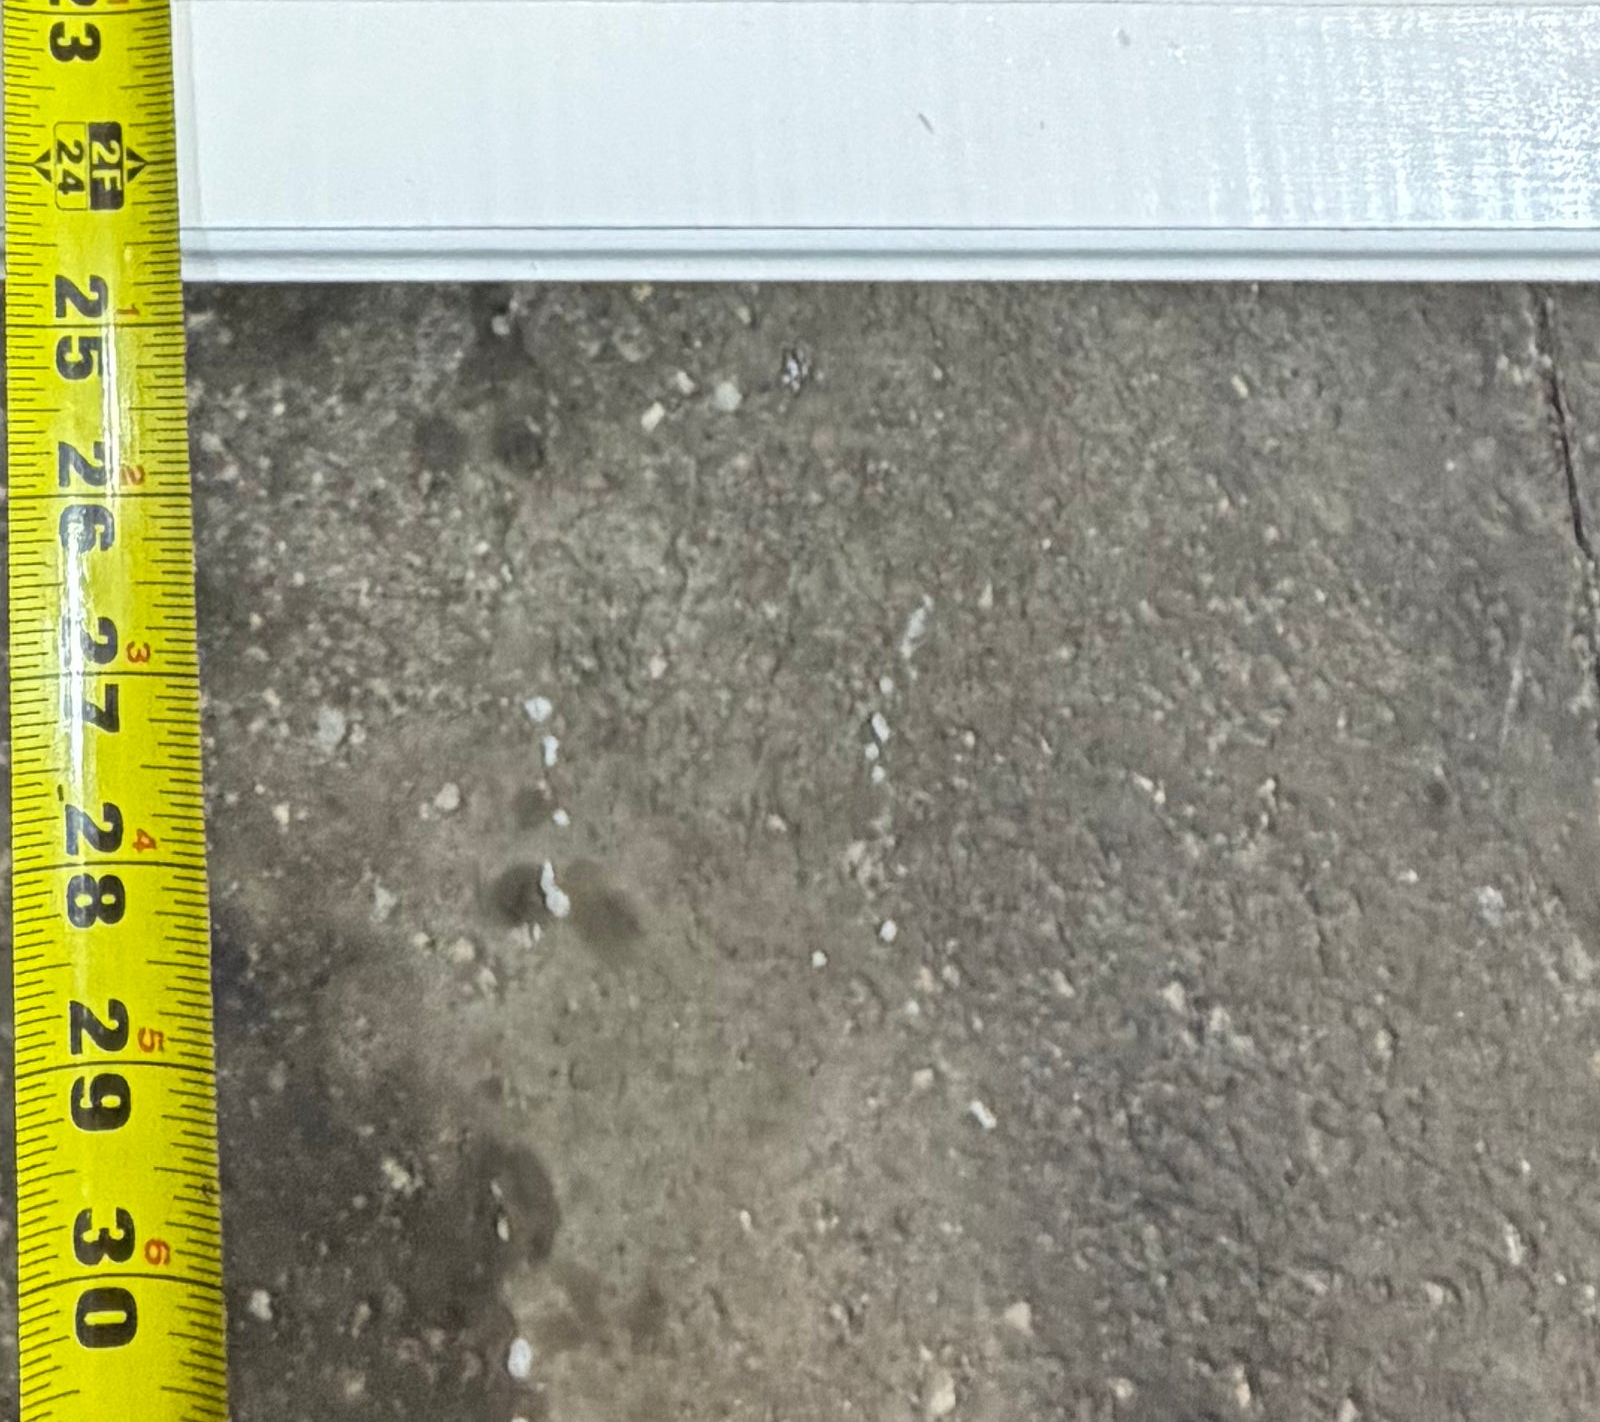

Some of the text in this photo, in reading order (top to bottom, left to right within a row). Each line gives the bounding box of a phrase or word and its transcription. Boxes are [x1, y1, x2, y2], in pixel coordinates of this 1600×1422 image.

[56, 138, 86, 196] 24
[91, 139, 124, 192] 2F
[55, 274, 108, 381] 25
[116, 303, 140, 316] 1
[58, 441, 115, 553] 26
[120, 464, 146, 486] 2
[60, 616, 120, 733] 27
[126, 640, 151, 664] 3
[65, 801, 126, 929] 28
[133, 828, 157, 853] 4
[70, 998, 132, 1132] 29
[137, 1026, 165, 1053] 5
[73, 1207, 138, 1349] 30
[144, 1238, 171, 1265] 6
